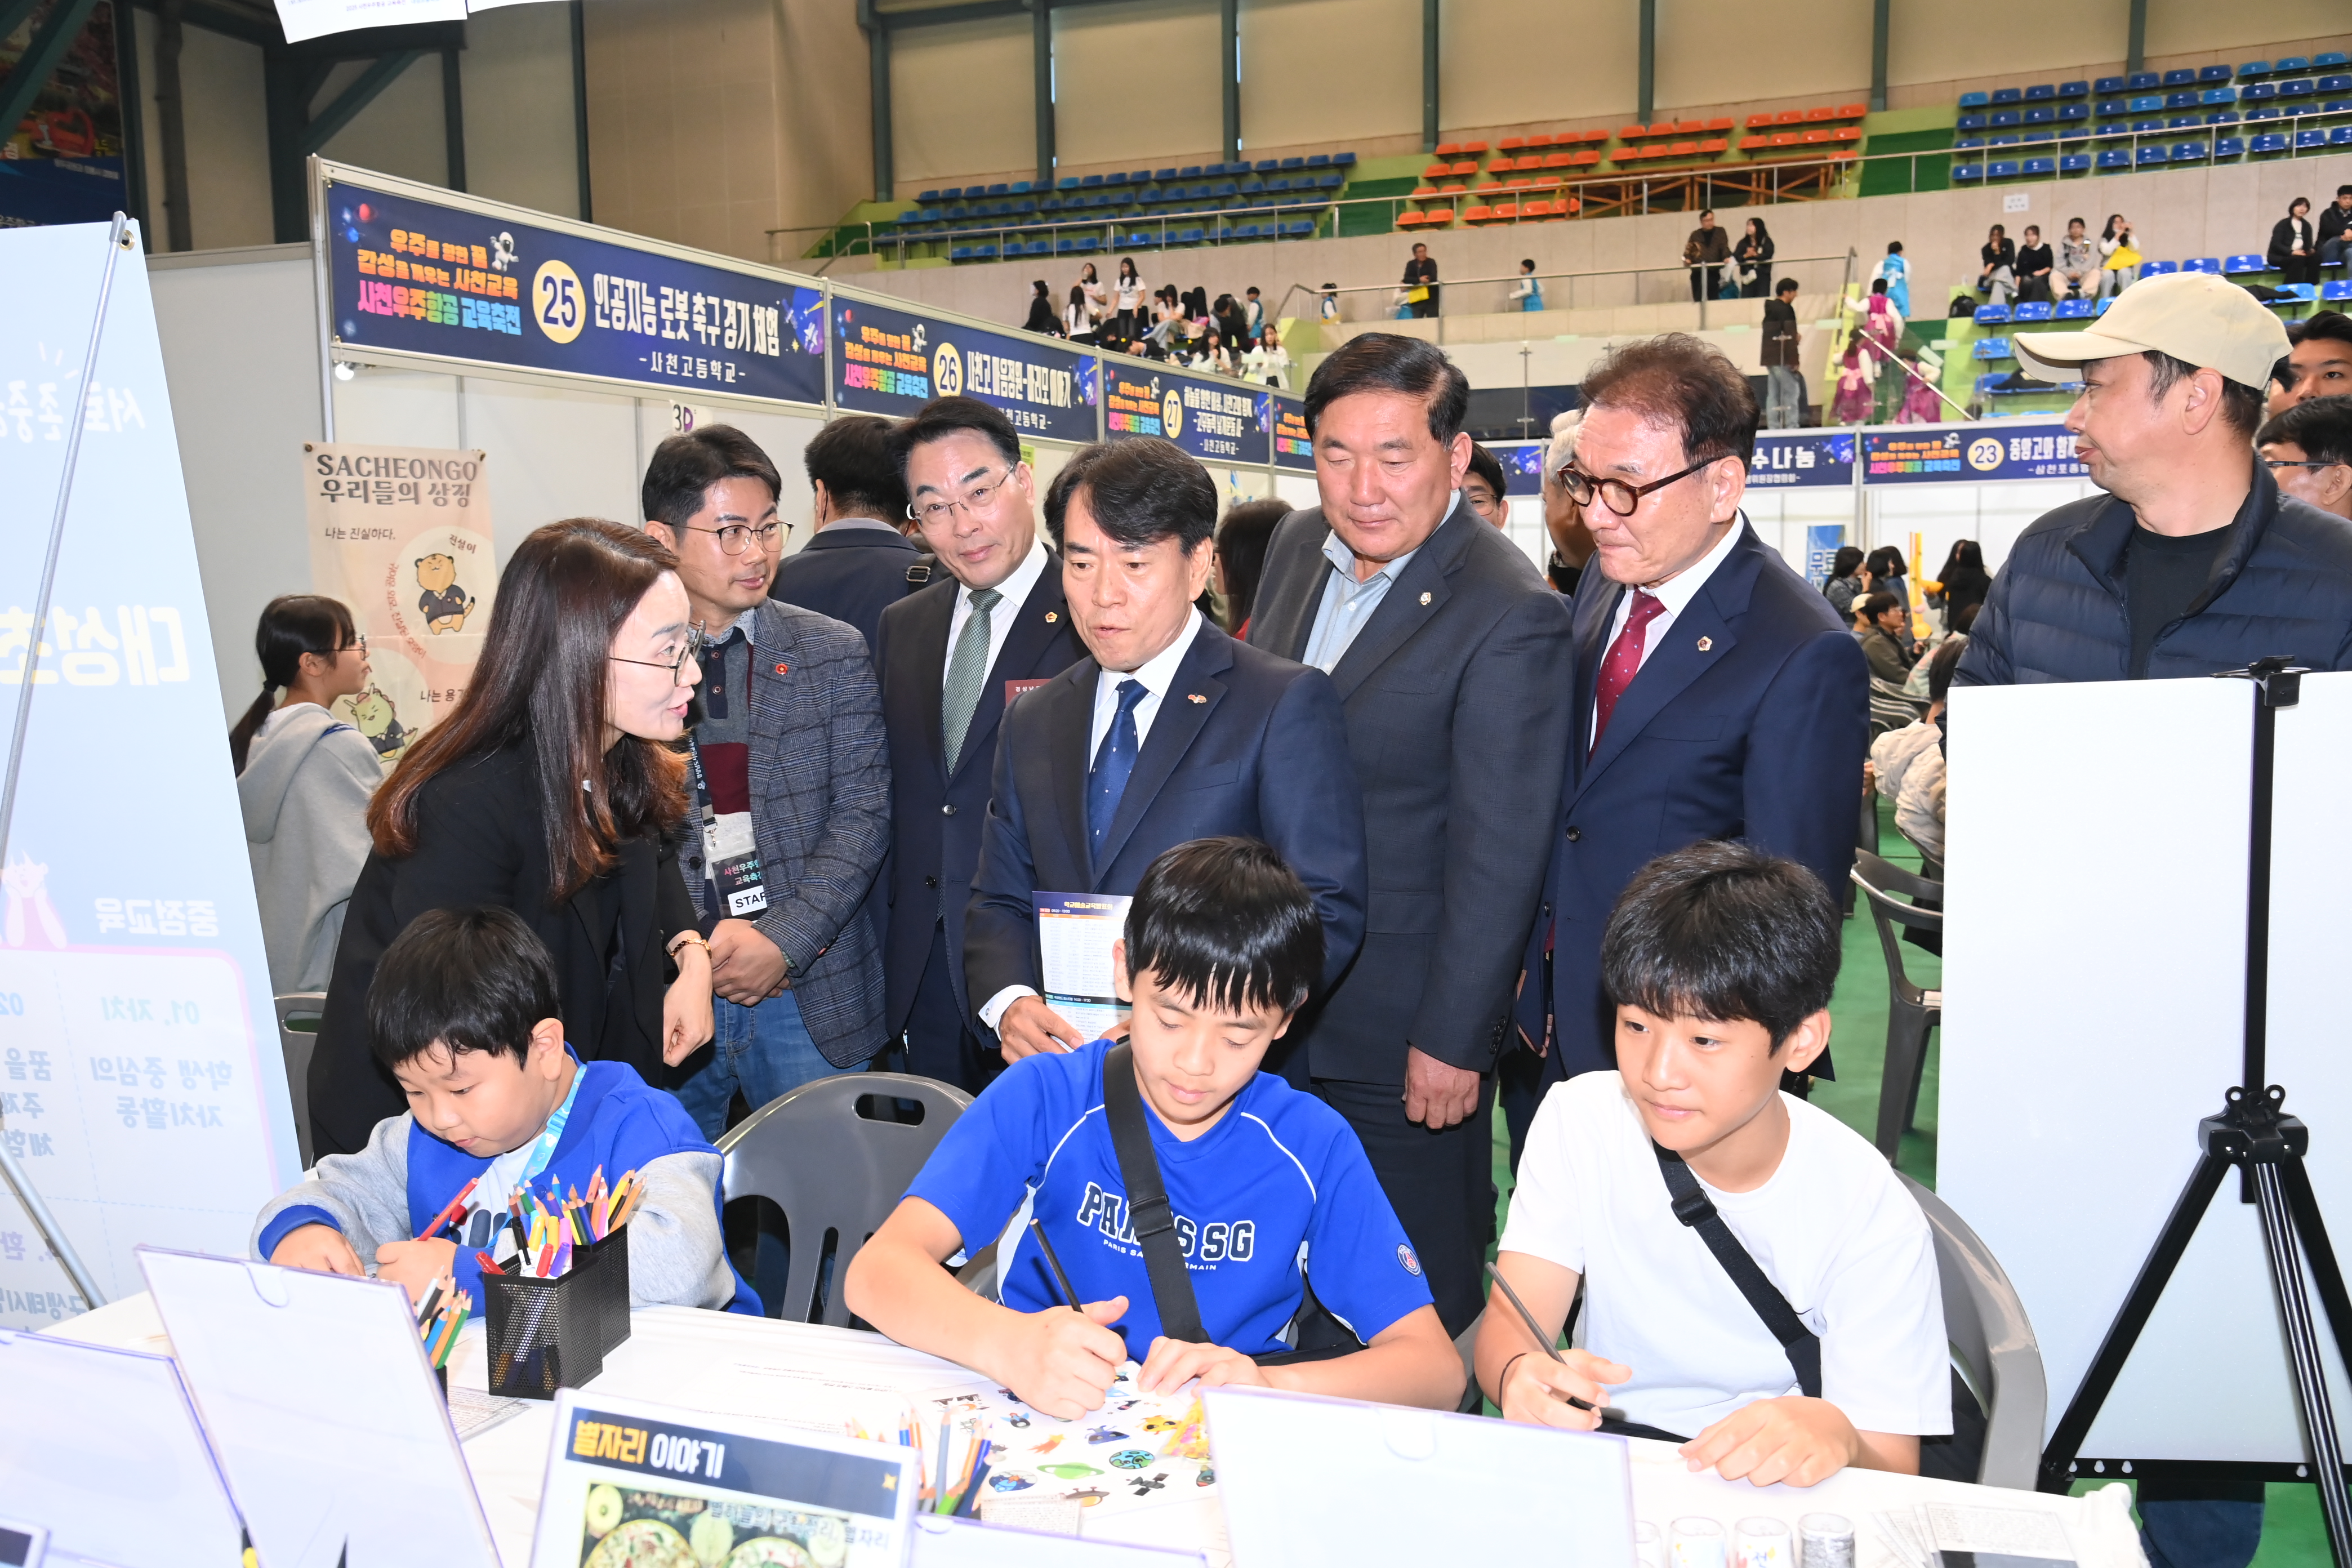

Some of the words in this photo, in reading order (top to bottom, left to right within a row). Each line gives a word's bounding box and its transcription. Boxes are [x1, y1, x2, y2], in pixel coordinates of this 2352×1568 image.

[390, 229, 439, 259] 우주를
[453, 268, 518, 300] 사천교육
[358, 280, 459, 326] 사천우주항공
[461, 297, 522, 335] 교육축전
[543, 275, 577, 328] 25
[593, 273, 657, 336] 인공지능
[660, 286, 689, 341] 로봇
[693, 292, 720, 346] 축구
[723, 299, 750, 352] 경기
[753, 305, 779, 357] 체험
[939, 354, 956, 391] 26
[967, 351, 991, 394] 사천고
[673, 404, 693, 433] 3D
[1168, 400, 1179, 429] 27
[317, 454, 477, 481] SACHEONGO
[1975, 445, 1997, 463] 23
[320, 479, 420, 505] 우리들의
[326, 528, 346, 538] 나는
[1076, 1181, 1197, 1257] PAS
[1200, 1220, 1255, 1262] SG
[1103, 1239, 1126, 1253] PARIS
[573, 1419, 648, 1464] 별자리
[650, 1433, 725, 1479] 이야기
